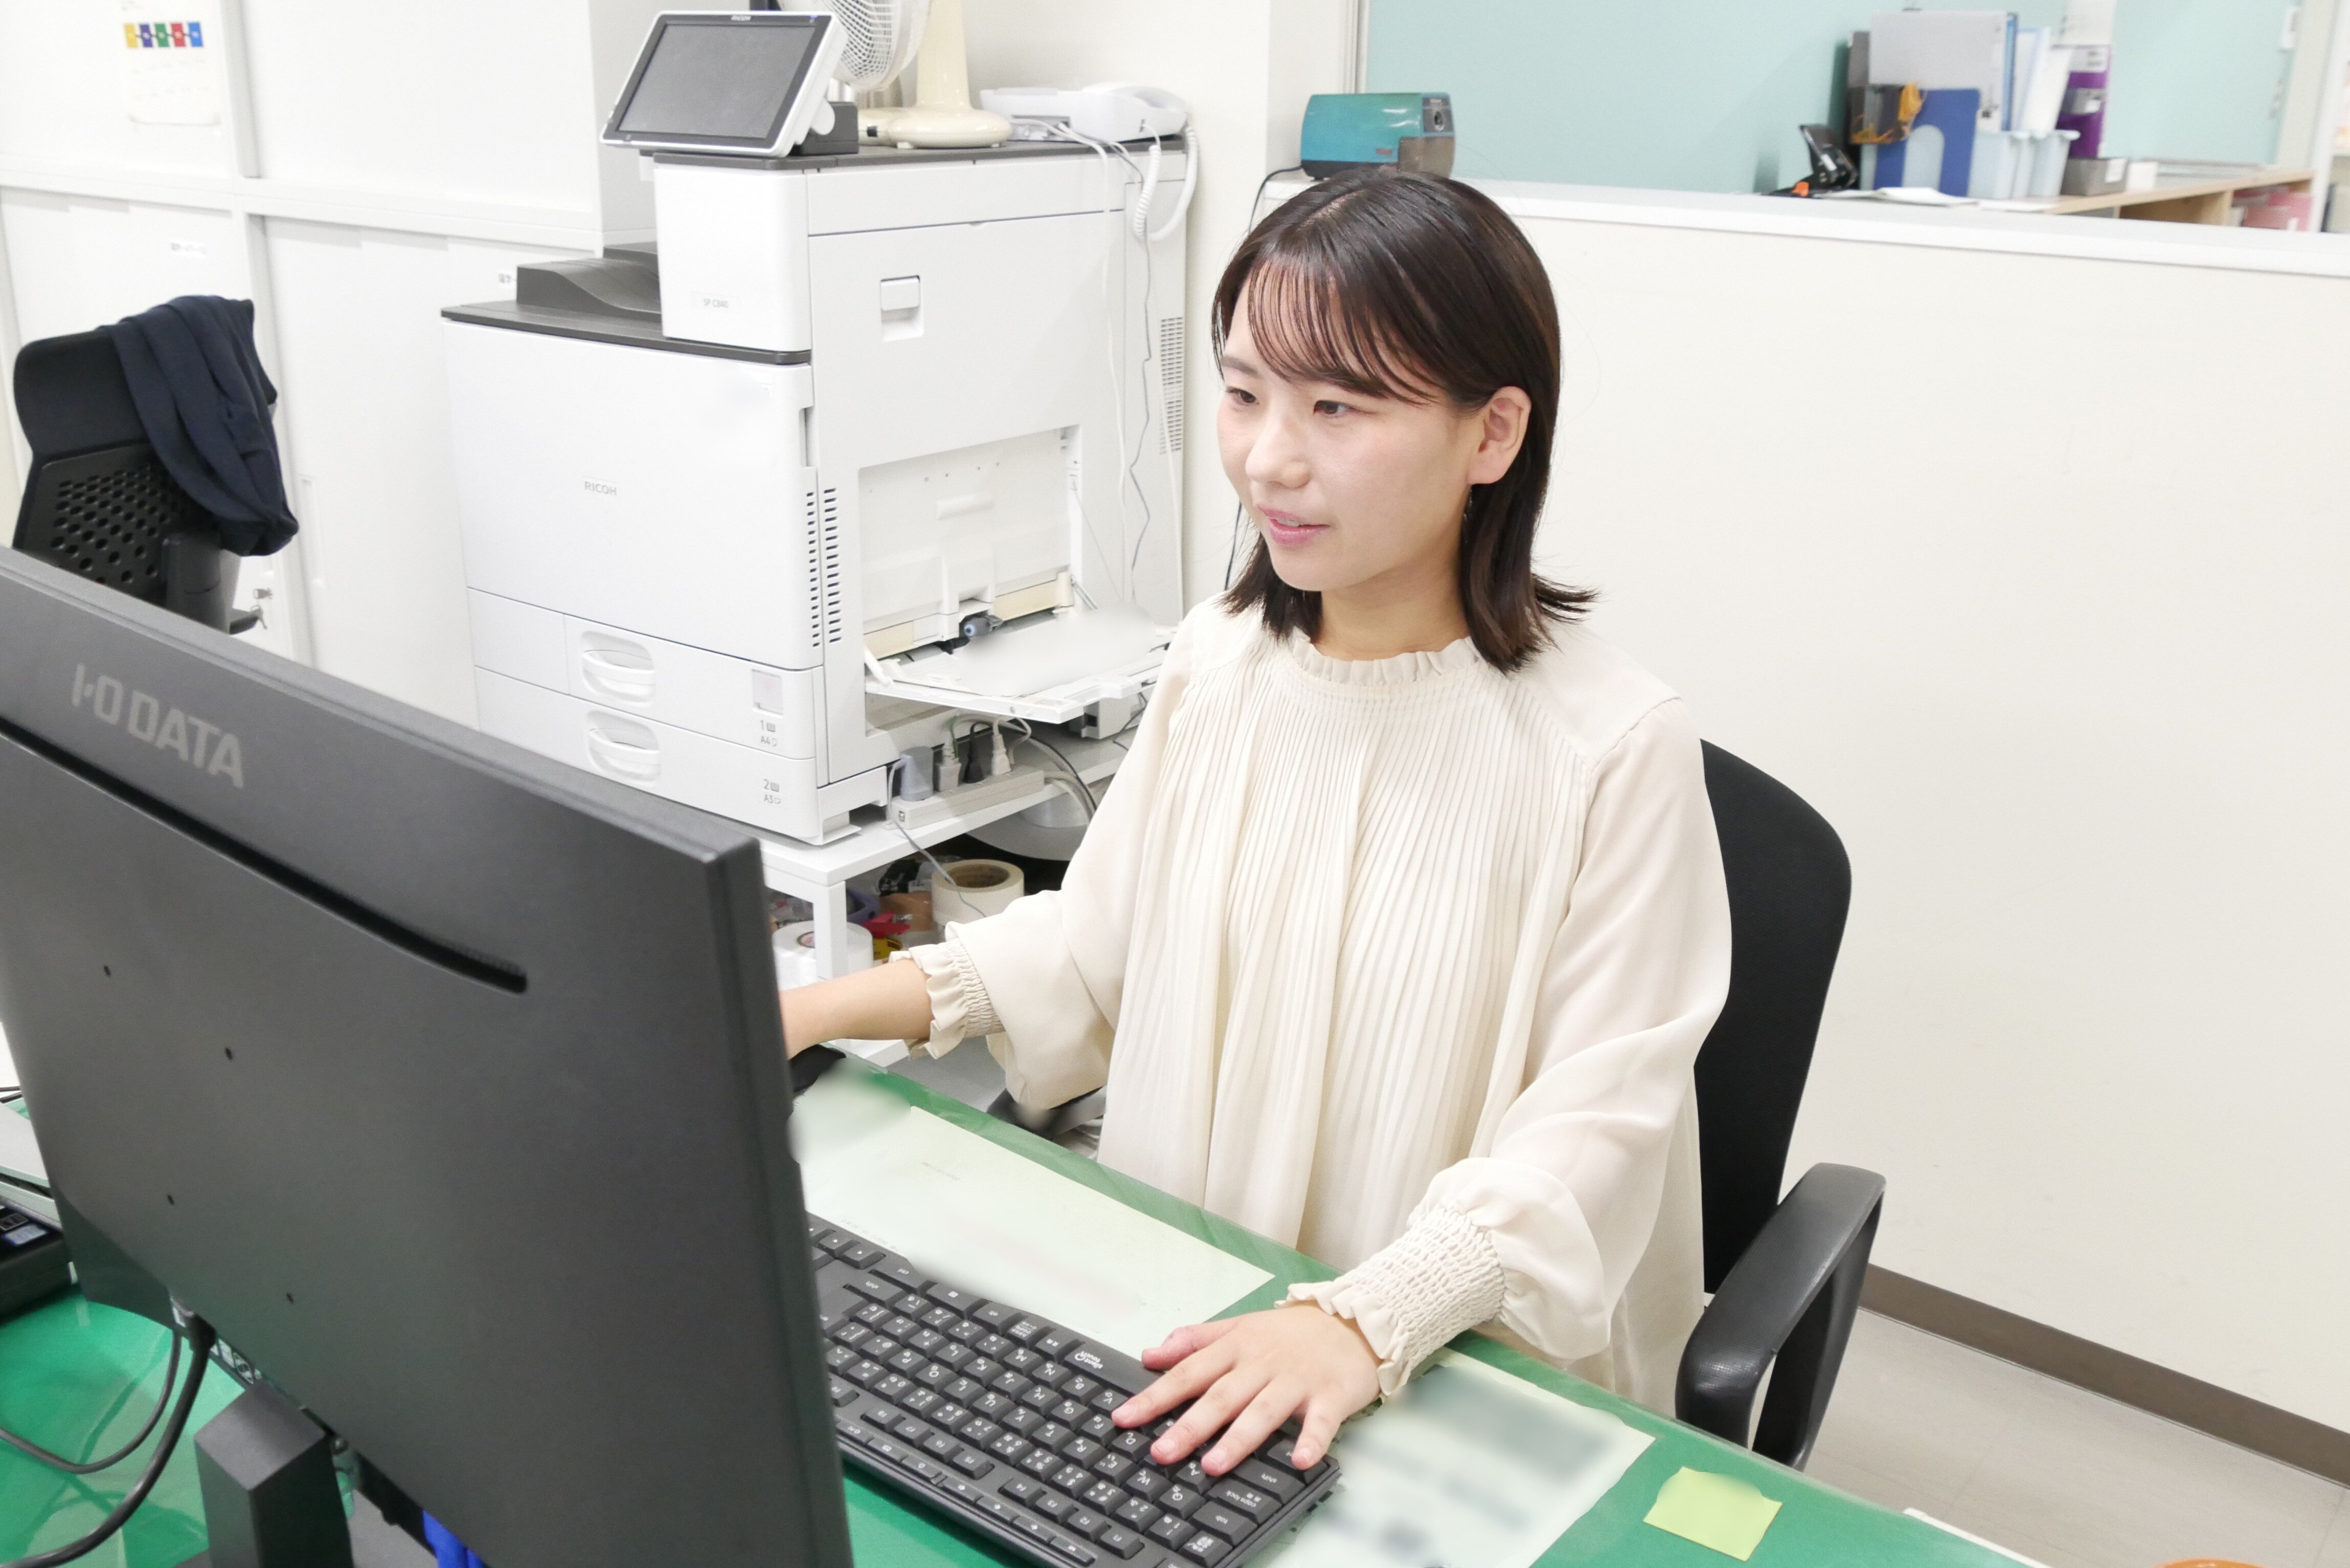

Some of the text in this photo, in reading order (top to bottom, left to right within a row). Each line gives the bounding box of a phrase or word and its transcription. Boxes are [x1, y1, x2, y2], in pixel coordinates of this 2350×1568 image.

[584, 481, 617, 496] RICOH
[760, 720, 764, 730] 1
[127, 689, 244, 788] DATA
[760, 736, 771, 745] A4
[764, 779, 769, 790] 2
[764, 794, 774, 804] A3
[1084, 1358, 1103, 1369] silent
[1137, 1476, 1150, 1485] W
[1261, 1474, 1277, 1483] shift
[1226, 1490, 1240, 1500] lock
[1240, 1497, 1256, 1507] caps
[1216, 1516, 1228, 1524] tab
